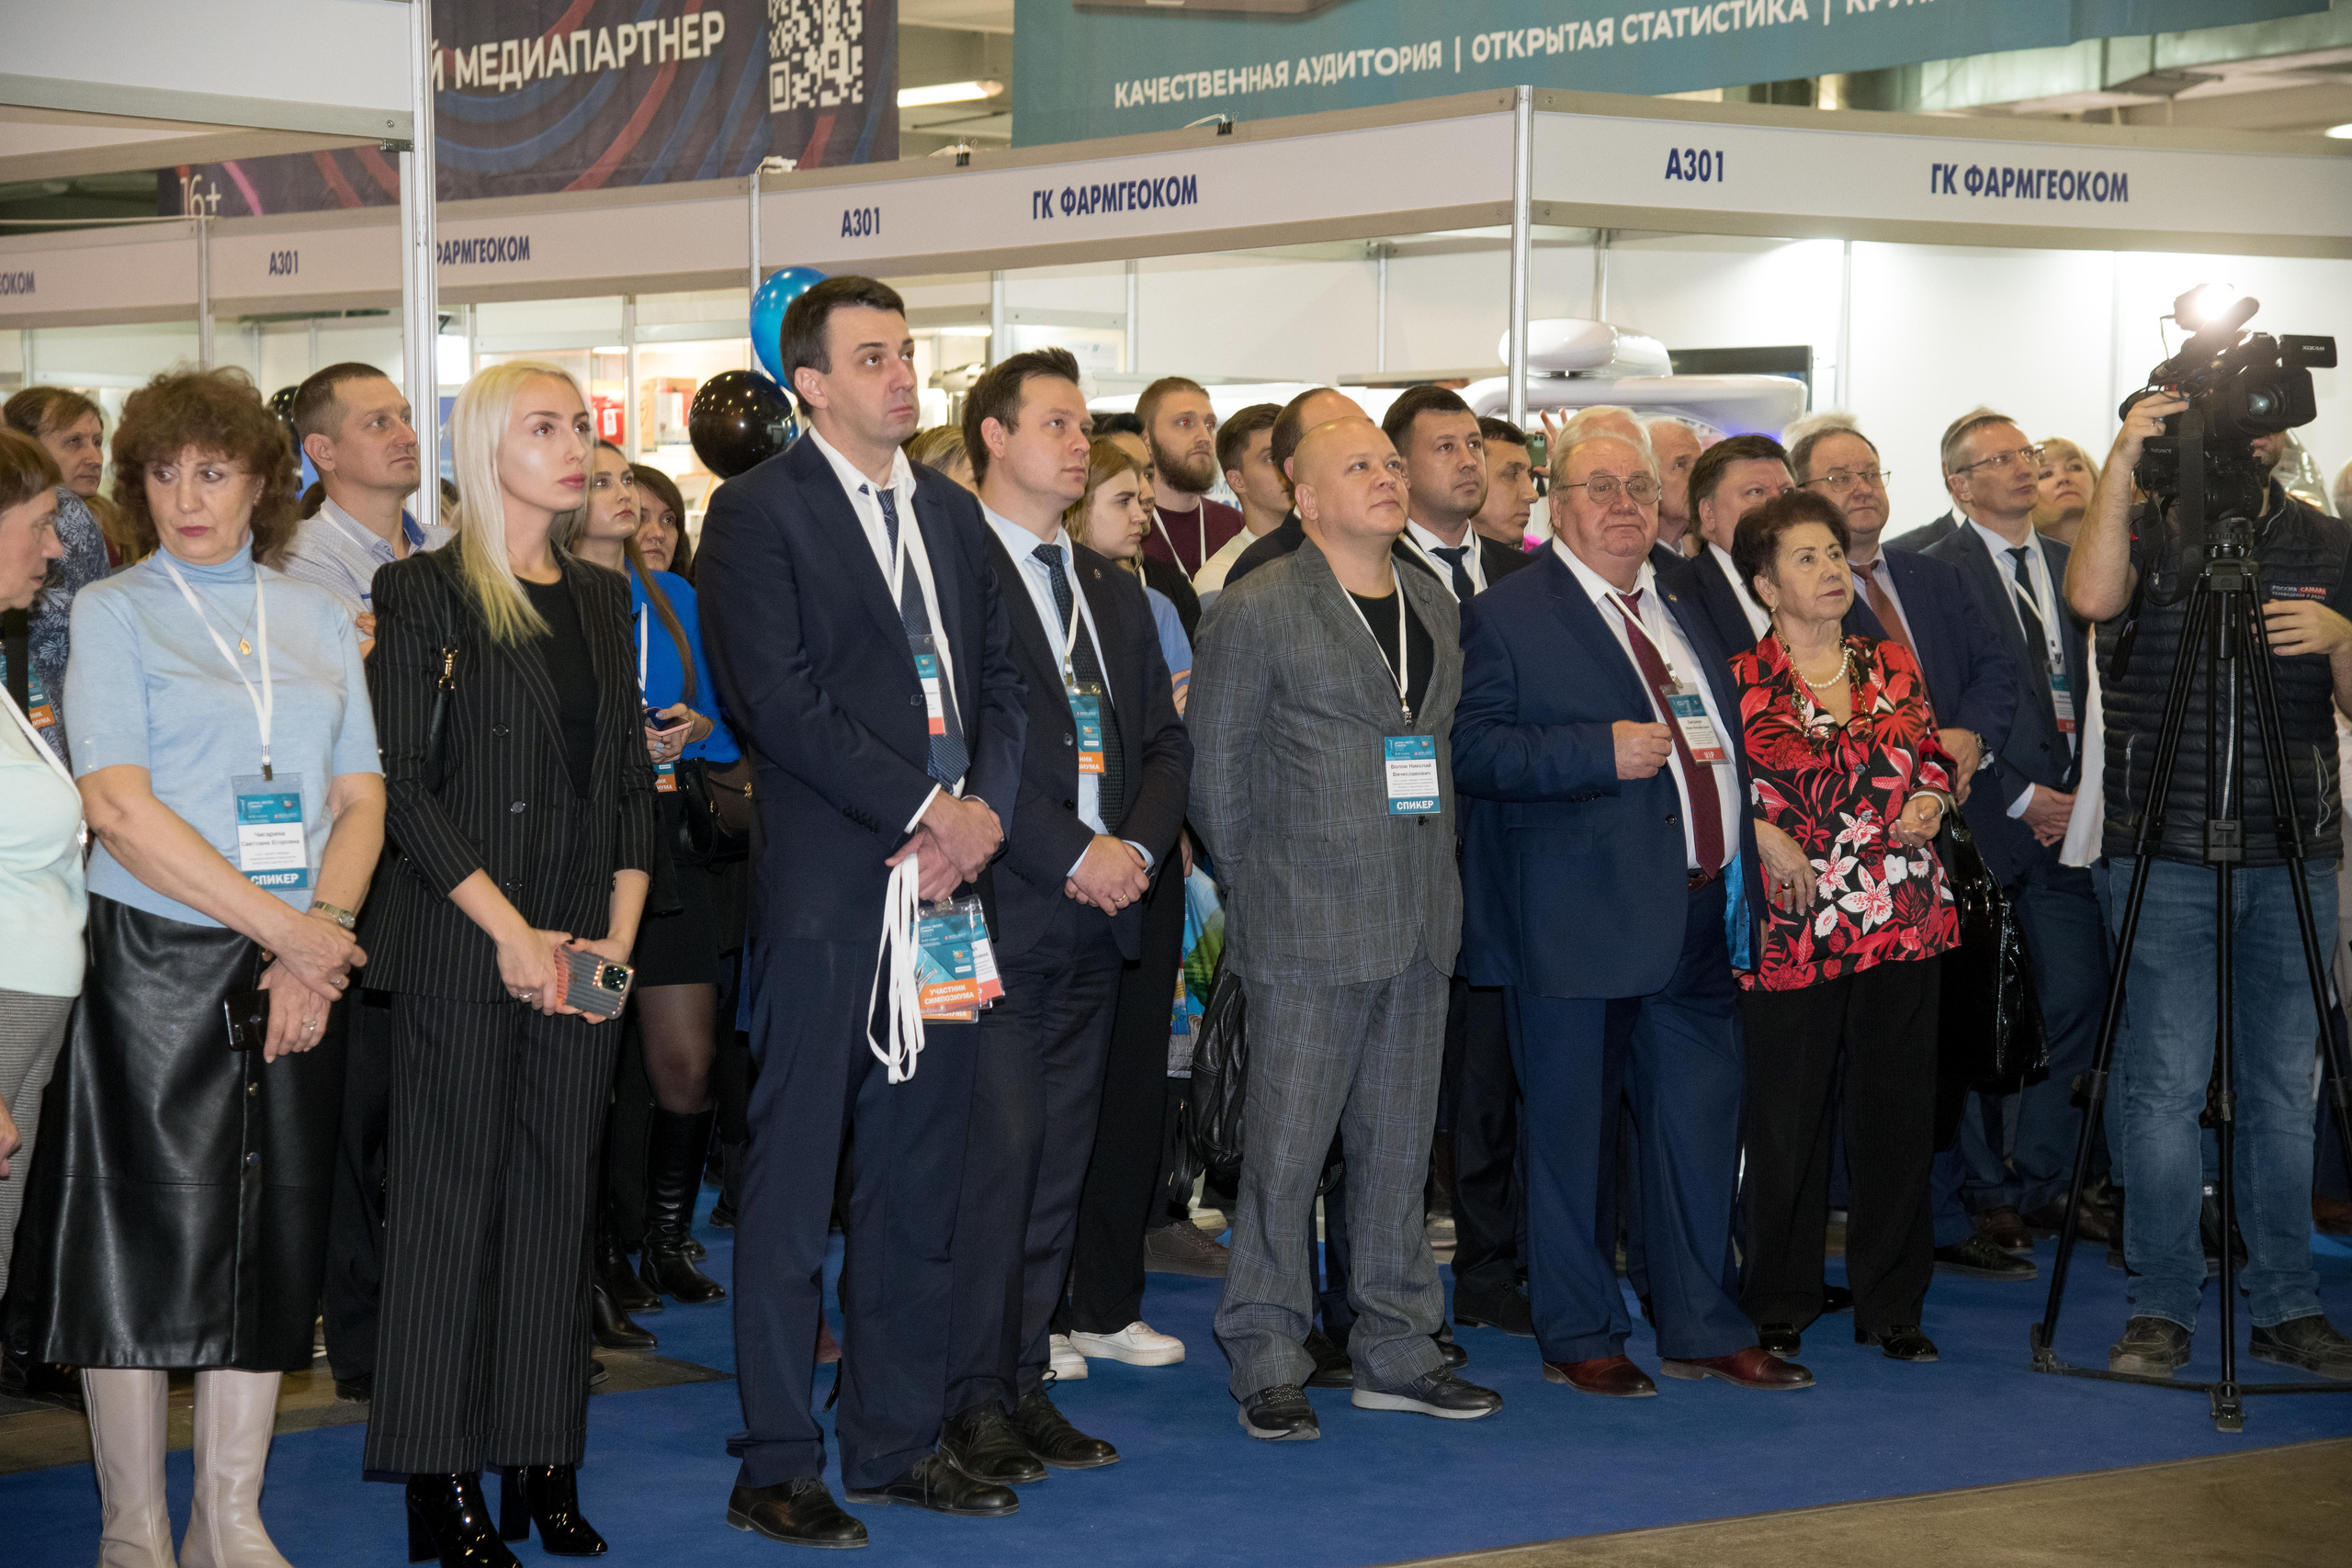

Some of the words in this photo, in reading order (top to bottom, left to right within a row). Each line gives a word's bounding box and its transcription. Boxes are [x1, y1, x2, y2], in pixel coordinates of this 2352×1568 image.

[455, 10, 725, 92] МЕДИАПАРТНЕР
[1114, 60, 1290, 108] КАЧЕСТВЕННАЯ
[1295, 39, 1442, 85] АУДИТОРИЯ
[1471, 17, 1614, 63] ОТКРЫТАЯ
[1621, 0, 1809, 44] СТАТИСТИКА
[1665, 148, 1724, 183] A301
[179, 174, 221, 216] 16+
[1033, 189, 1054, 220] ГК
[1060, 175, 1198, 217] ФАРМГЕОКОМ
[1931, 163, 1958, 195] ГК
[1964, 164, 2129, 203] ФАРМГЕОКОМ
[841, 207, 880, 238] A301
[268, 250, 299, 276] A301
[1396, 801, 1434, 810] СПИКЕР
[251, 874, 299, 885] СПИКЕР
[924, 992, 974, 1004] СИМПОЗИУМА
[930, 985, 966, 995] УЧАСТНИК
